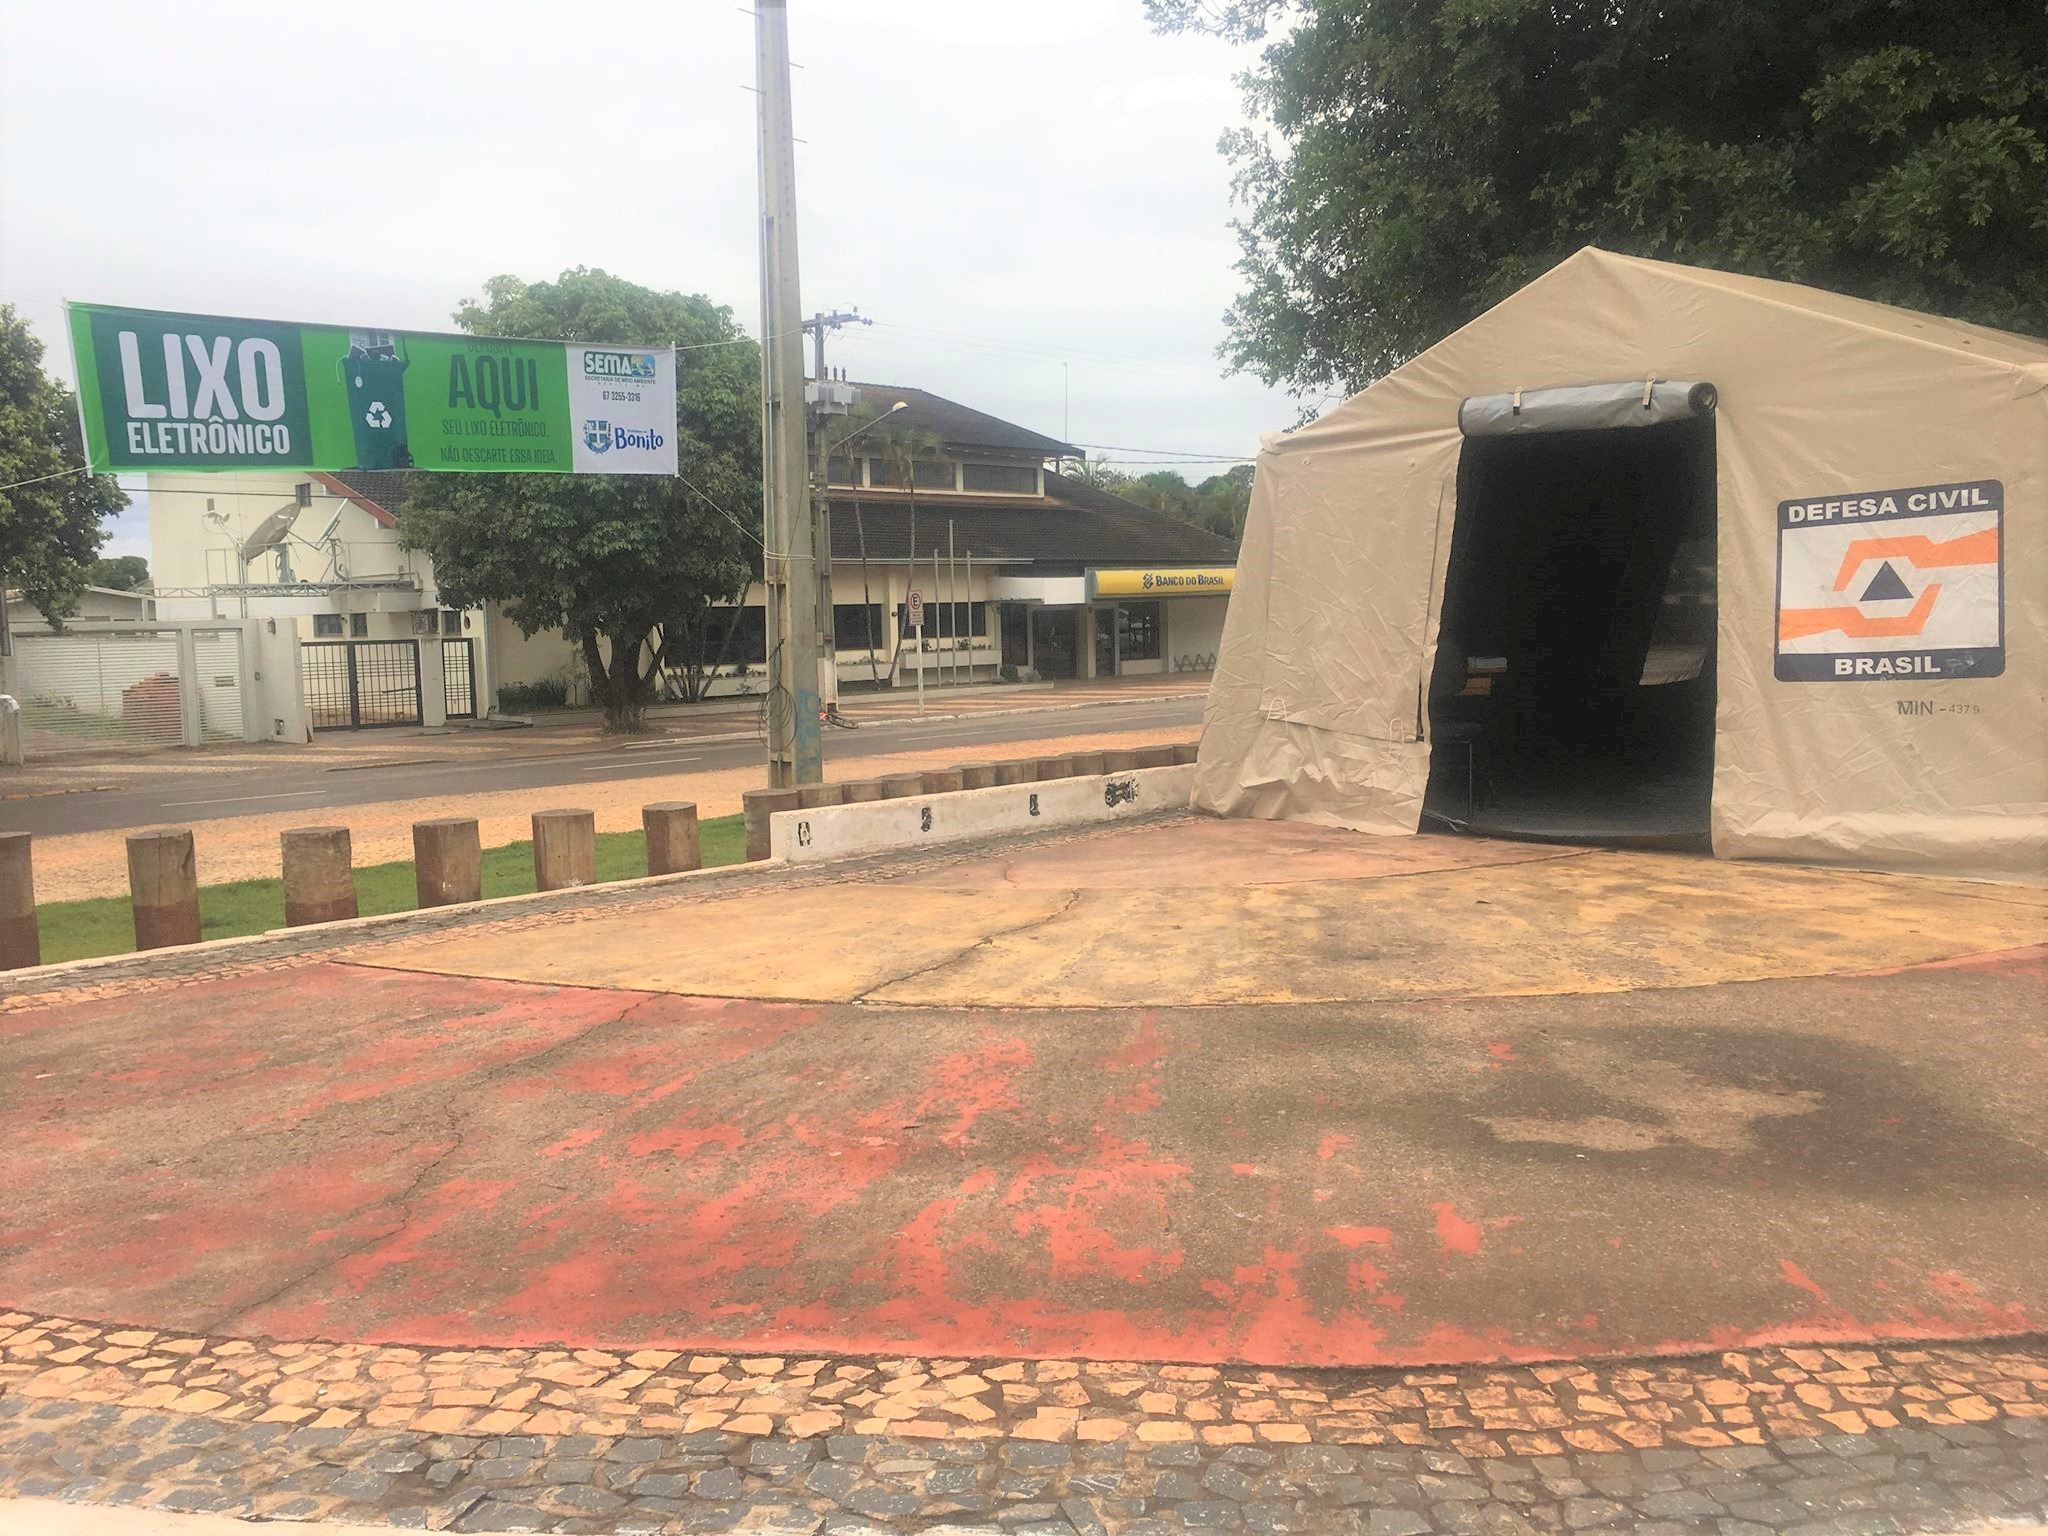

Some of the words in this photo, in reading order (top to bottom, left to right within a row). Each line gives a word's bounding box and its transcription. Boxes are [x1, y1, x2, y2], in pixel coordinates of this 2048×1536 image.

[585, 353, 632, 375] SEMA
[118, 330, 286, 421] LIXO
[448, 353, 539, 419] AQUI
[602, 390, 610, 401] 67
[127, 415, 291, 455] ELETRÔNICO
[442, 419, 462, 435] SEU
[464, 420, 486, 436] LIXO
[614, 427, 664, 451] Bonito
[441, 445, 460, 462] NÃO
[462, 448, 507, 463] DESCARTE
[510, 448, 532, 463] ESSA
[1788, 496, 1898, 523] DEFESA
[1907, 488, 1989, 512] CIVIL
[1155, 575, 1184, 587] BANCO
[1185, 576, 1197, 586] DO
[1197, 574, 1225, 586] BRASIL
[1834, 656, 1941, 675] BRASIL
[1897, 700, 1933, 715] MIN
